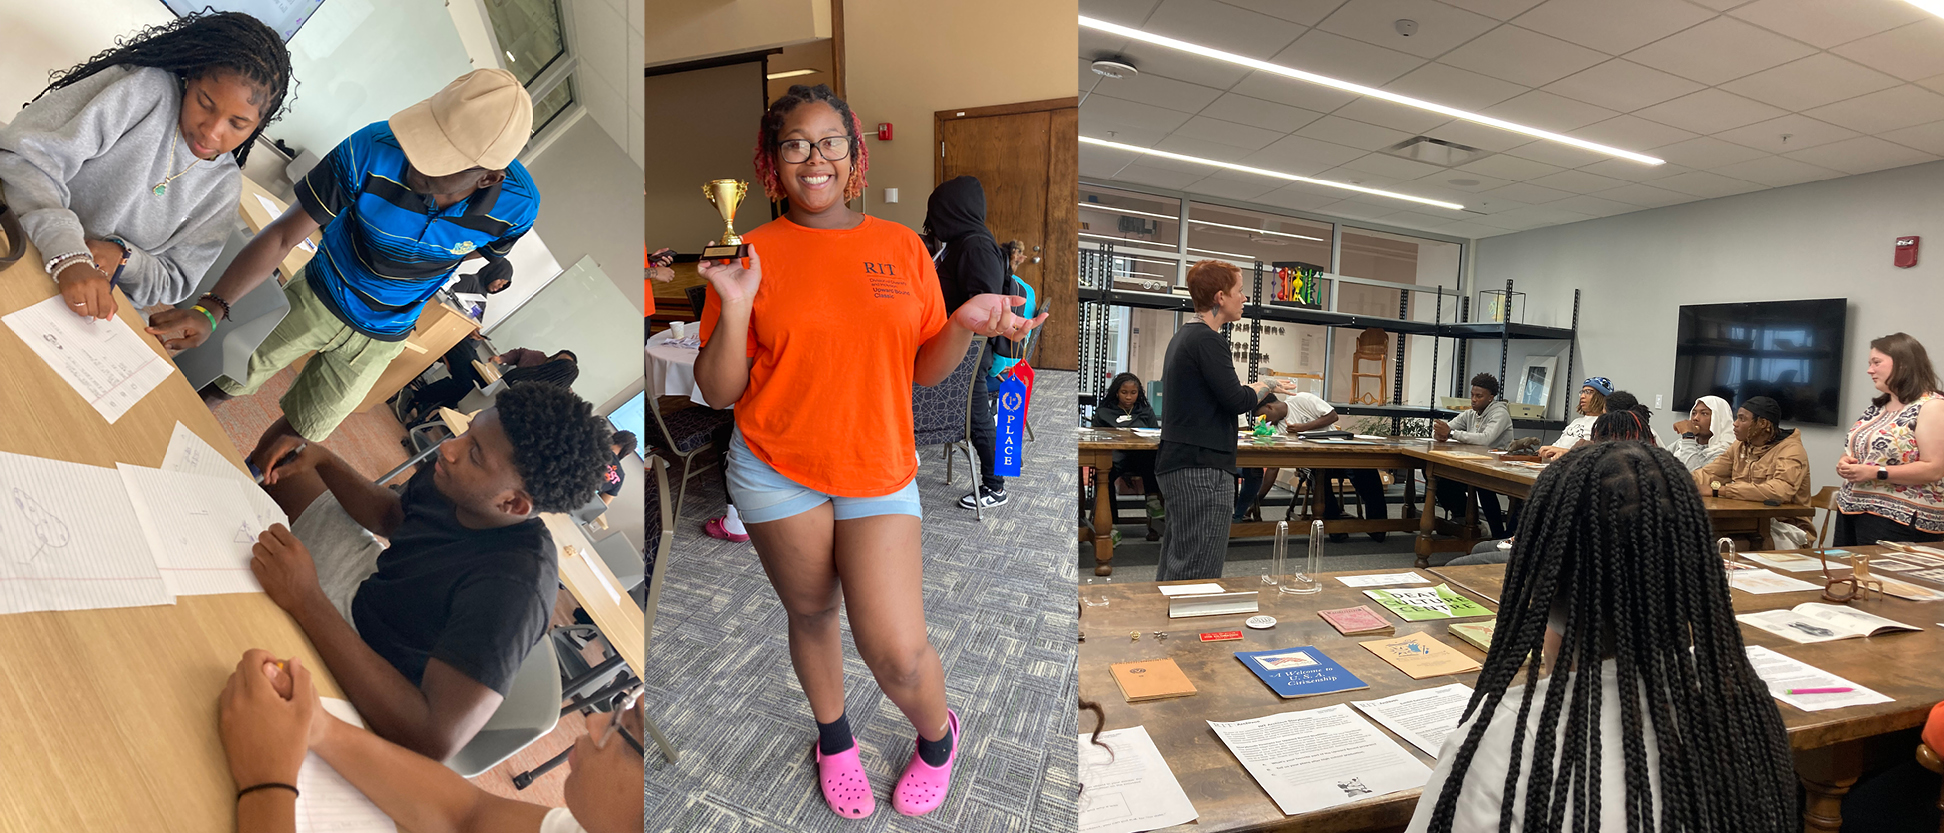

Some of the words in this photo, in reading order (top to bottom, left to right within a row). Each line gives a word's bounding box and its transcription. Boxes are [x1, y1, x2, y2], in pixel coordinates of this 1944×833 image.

[863, 262, 896, 276] RIT
[1004, 415, 1016, 466] PLACE
[1391, 591, 1437, 599] DEAF
[1383, 597, 1466, 606] CULTURE
[1400, 603, 1476, 613] CENTRE
[1285, 668, 1322, 677] Welcome
[1287, 675, 1338, 686] Citizenship
